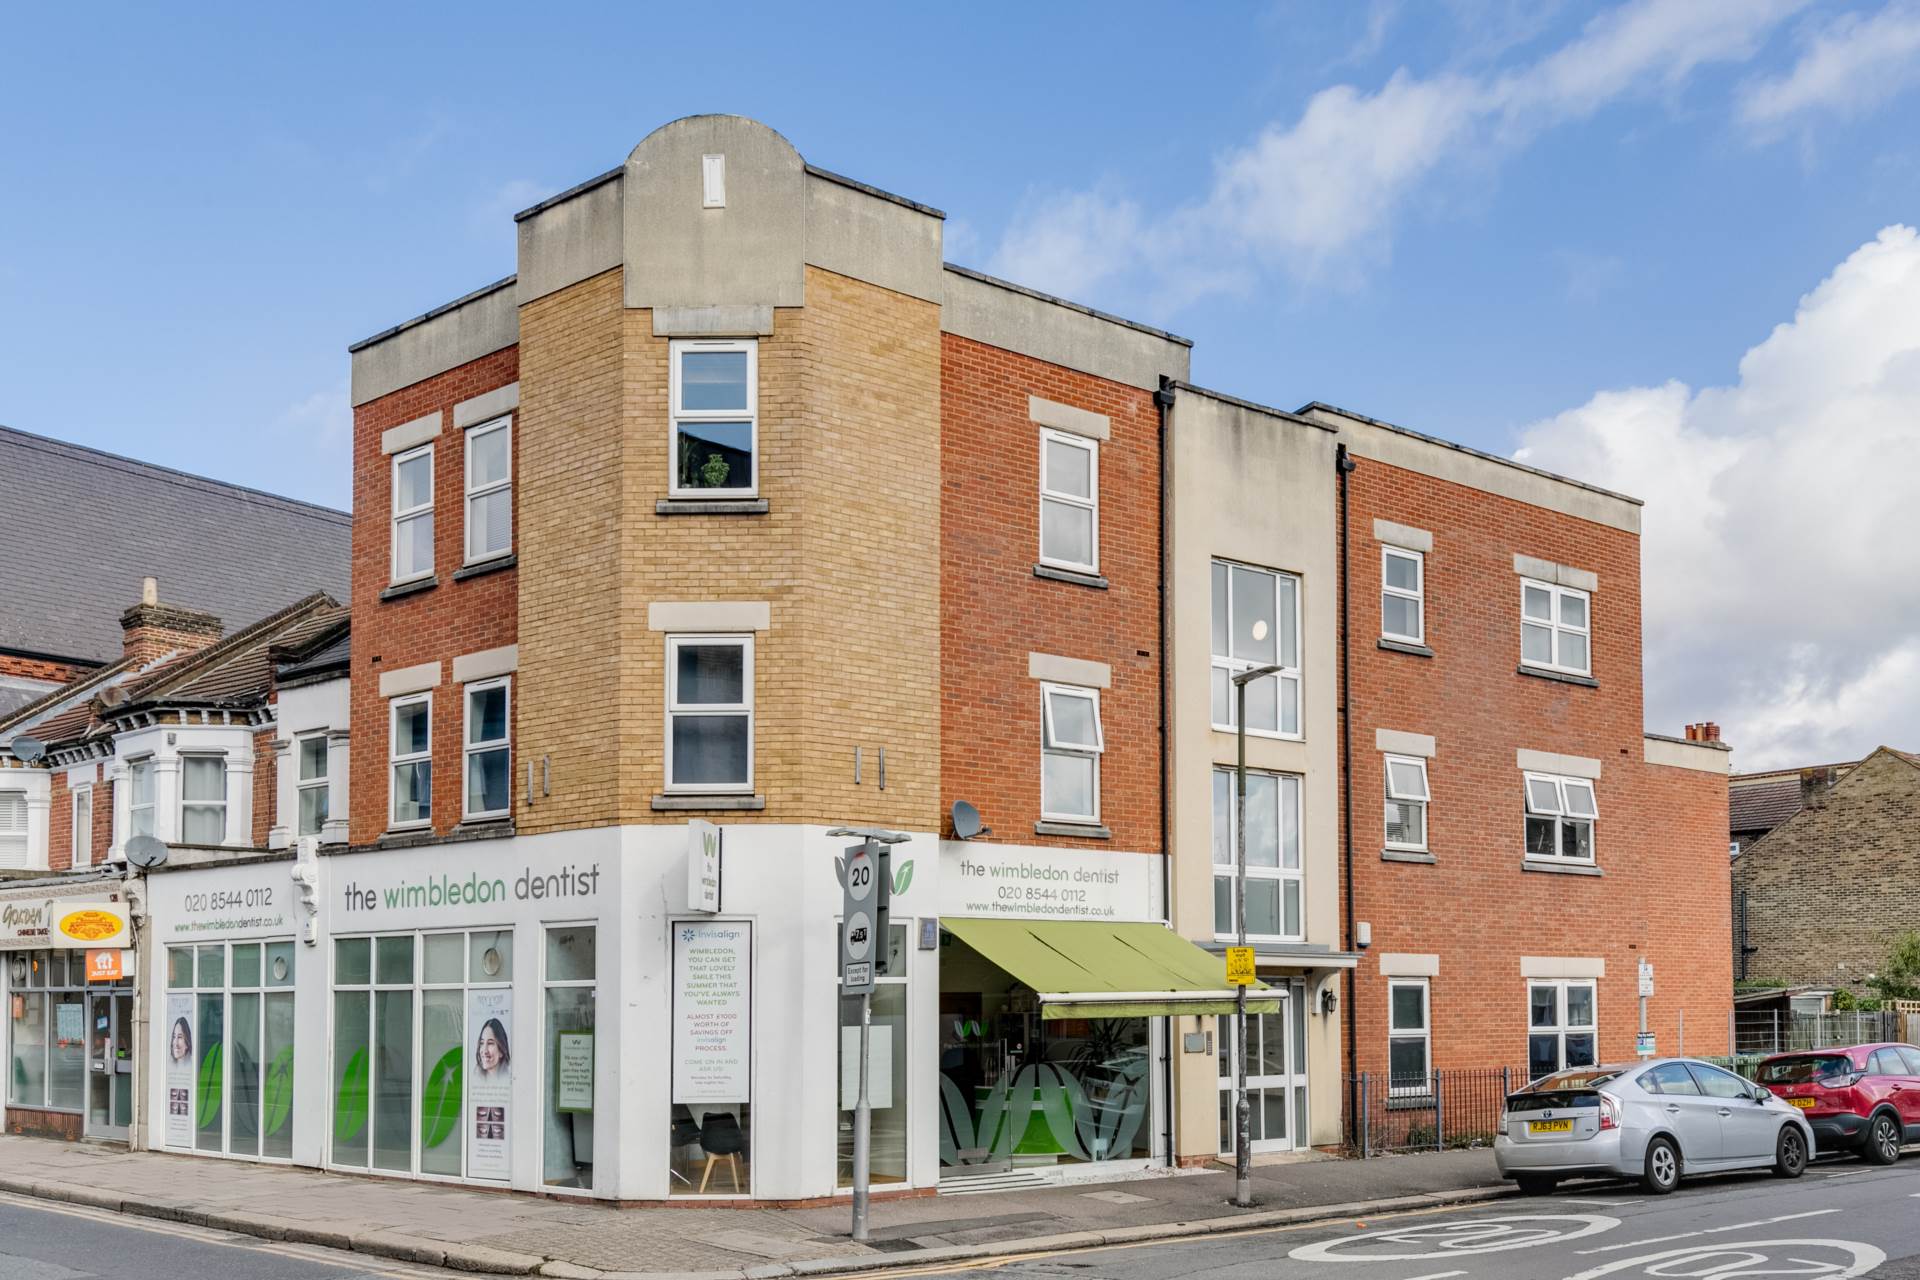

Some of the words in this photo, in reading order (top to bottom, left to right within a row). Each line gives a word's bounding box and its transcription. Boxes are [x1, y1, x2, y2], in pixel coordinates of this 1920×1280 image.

[852, 866, 870, 887] 20
[960, 860, 985, 877] the
[989, 862, 1069, 881] wimbledon
[1073, 866, 1120, 884] dentist
[345, 881, 377, 912] the
[384, 871, 506, 909] wimbledon
[514, 863, 600, 900] dentist
[998, 886, 1022, 899] 020
[1025, 887, 1057, 901] 8544
[1060, 889, 1086, 902] 0112
[184, 894, 208, 912] 020
[210, 890, 243, 911] 8544
[245, 887, 273, 907] 0112
[966, 901, 1114, 916] www.thewimbledondentist.co.uk
[174, 914, 283, 932] www.thewimbledondentist.co.uk
[699, 929, 742, 940] invisalign
[1532, 1122, 1552, 1131] RJ63
[1553, 1120, 1569, 1129] PVN
[1376, 1224, 1562, 1249] 20
